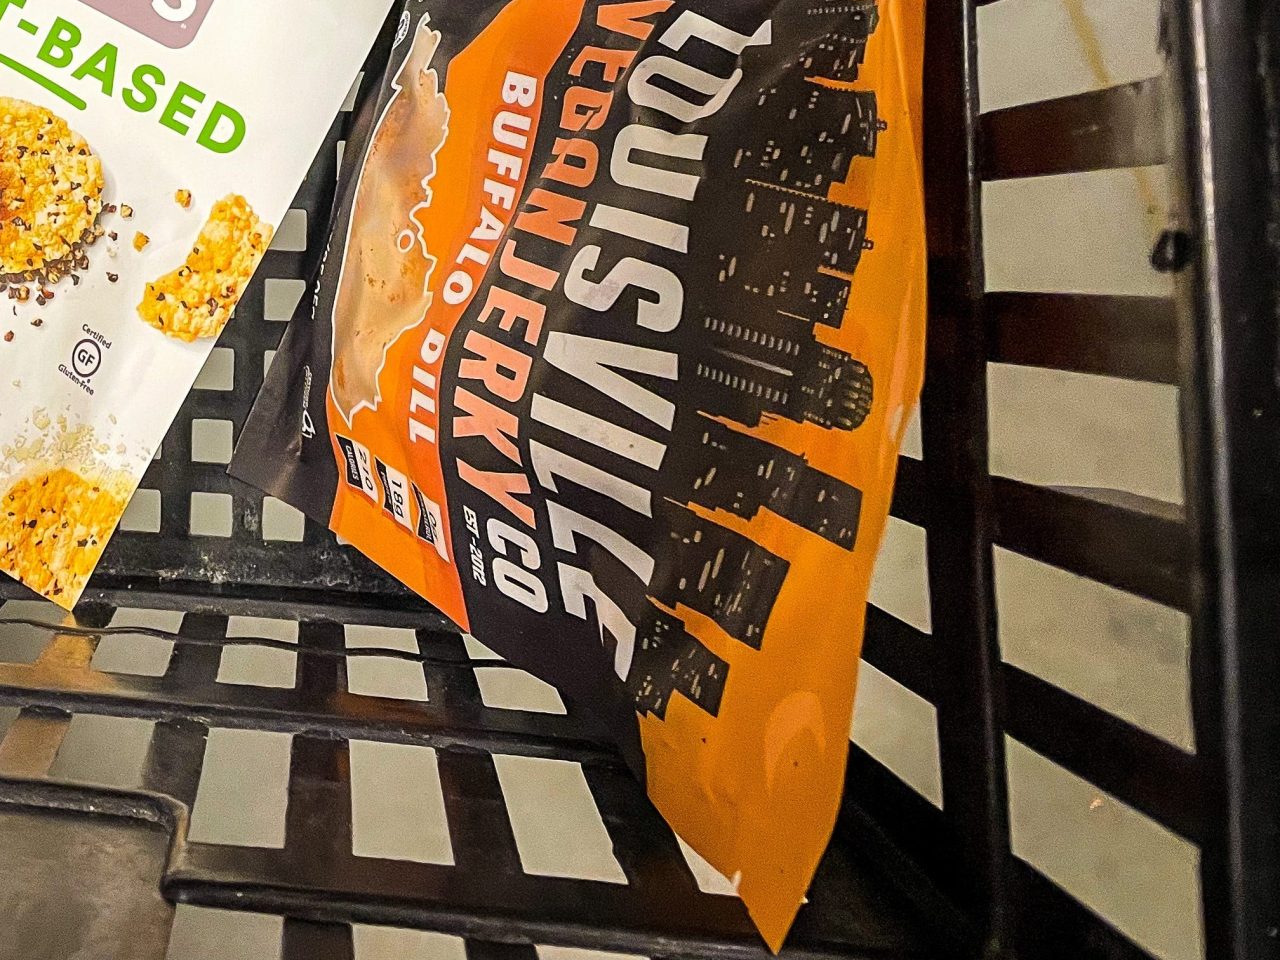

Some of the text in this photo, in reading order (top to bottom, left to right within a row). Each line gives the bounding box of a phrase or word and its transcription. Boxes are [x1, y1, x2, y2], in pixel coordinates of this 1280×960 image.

[408, 68, 545, 445] BUFFALO DILL
[81, 323, 113, 350] Certified
[529, 9, 773, 683] LOUISVILLE
[77, 348, 96, 367] GF
[345, 444, 360, 481] CALORIES
[358, 447, 374, 491] 210
[391, 479, 405, 518] 18g
